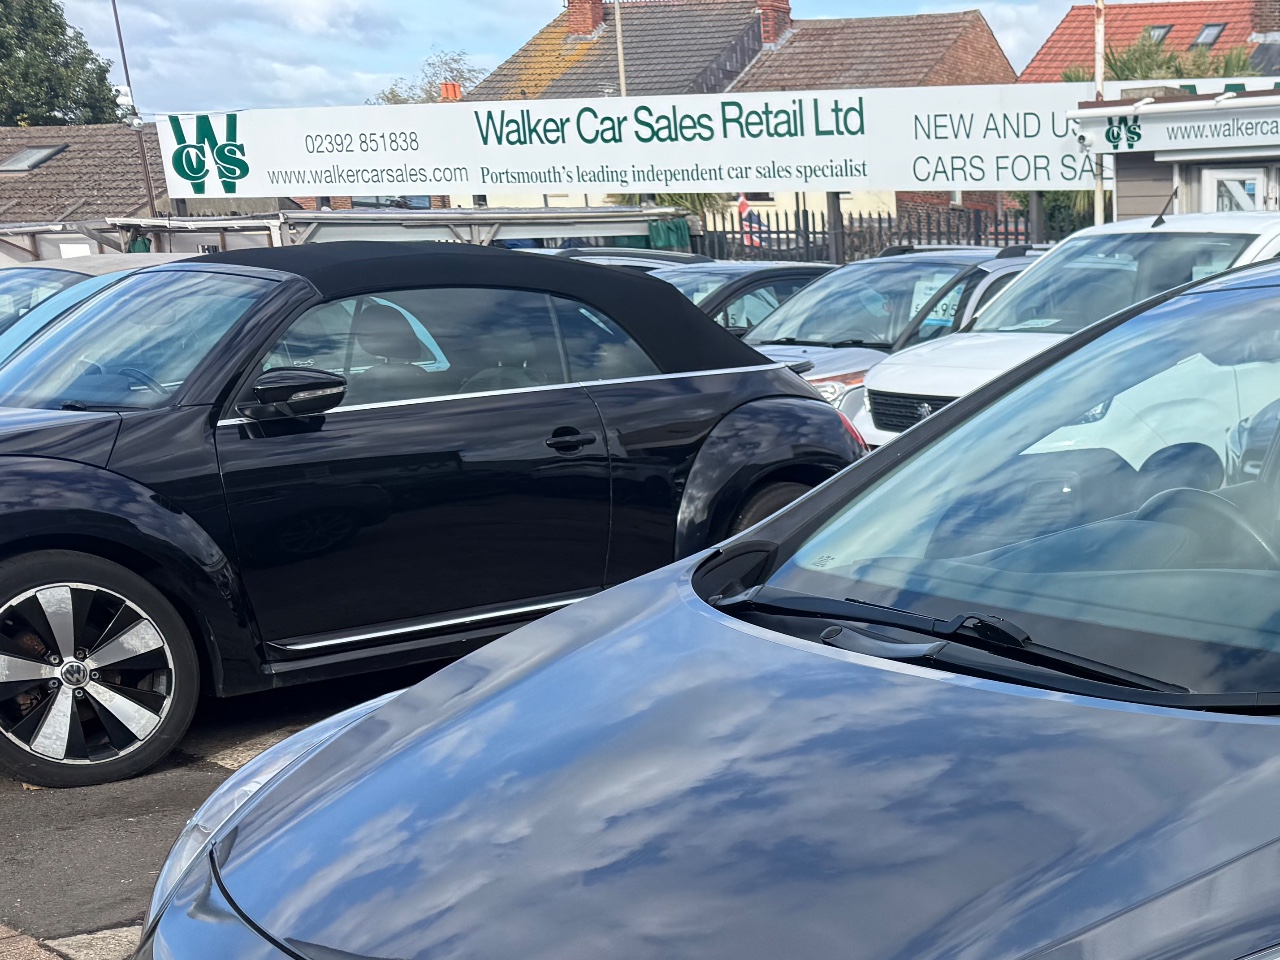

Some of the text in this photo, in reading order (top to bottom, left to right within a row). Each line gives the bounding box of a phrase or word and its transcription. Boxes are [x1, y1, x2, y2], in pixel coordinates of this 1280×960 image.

[474, 97, 865, 146] Walker Car Sales Retail Ltd
[915, 114, 974, 140] NEW
[984, 112, 1041, 139] AND
[305, 131, 419, 154] 02392 851838
[267, 163, 469, 185] www.walkercarsales.com
[481, 159, 868, 187] Portsmouth's leading independent car sales specialist
[913, 155, 986, 182] CARS
[996, 154, 1051, 181] FOR
